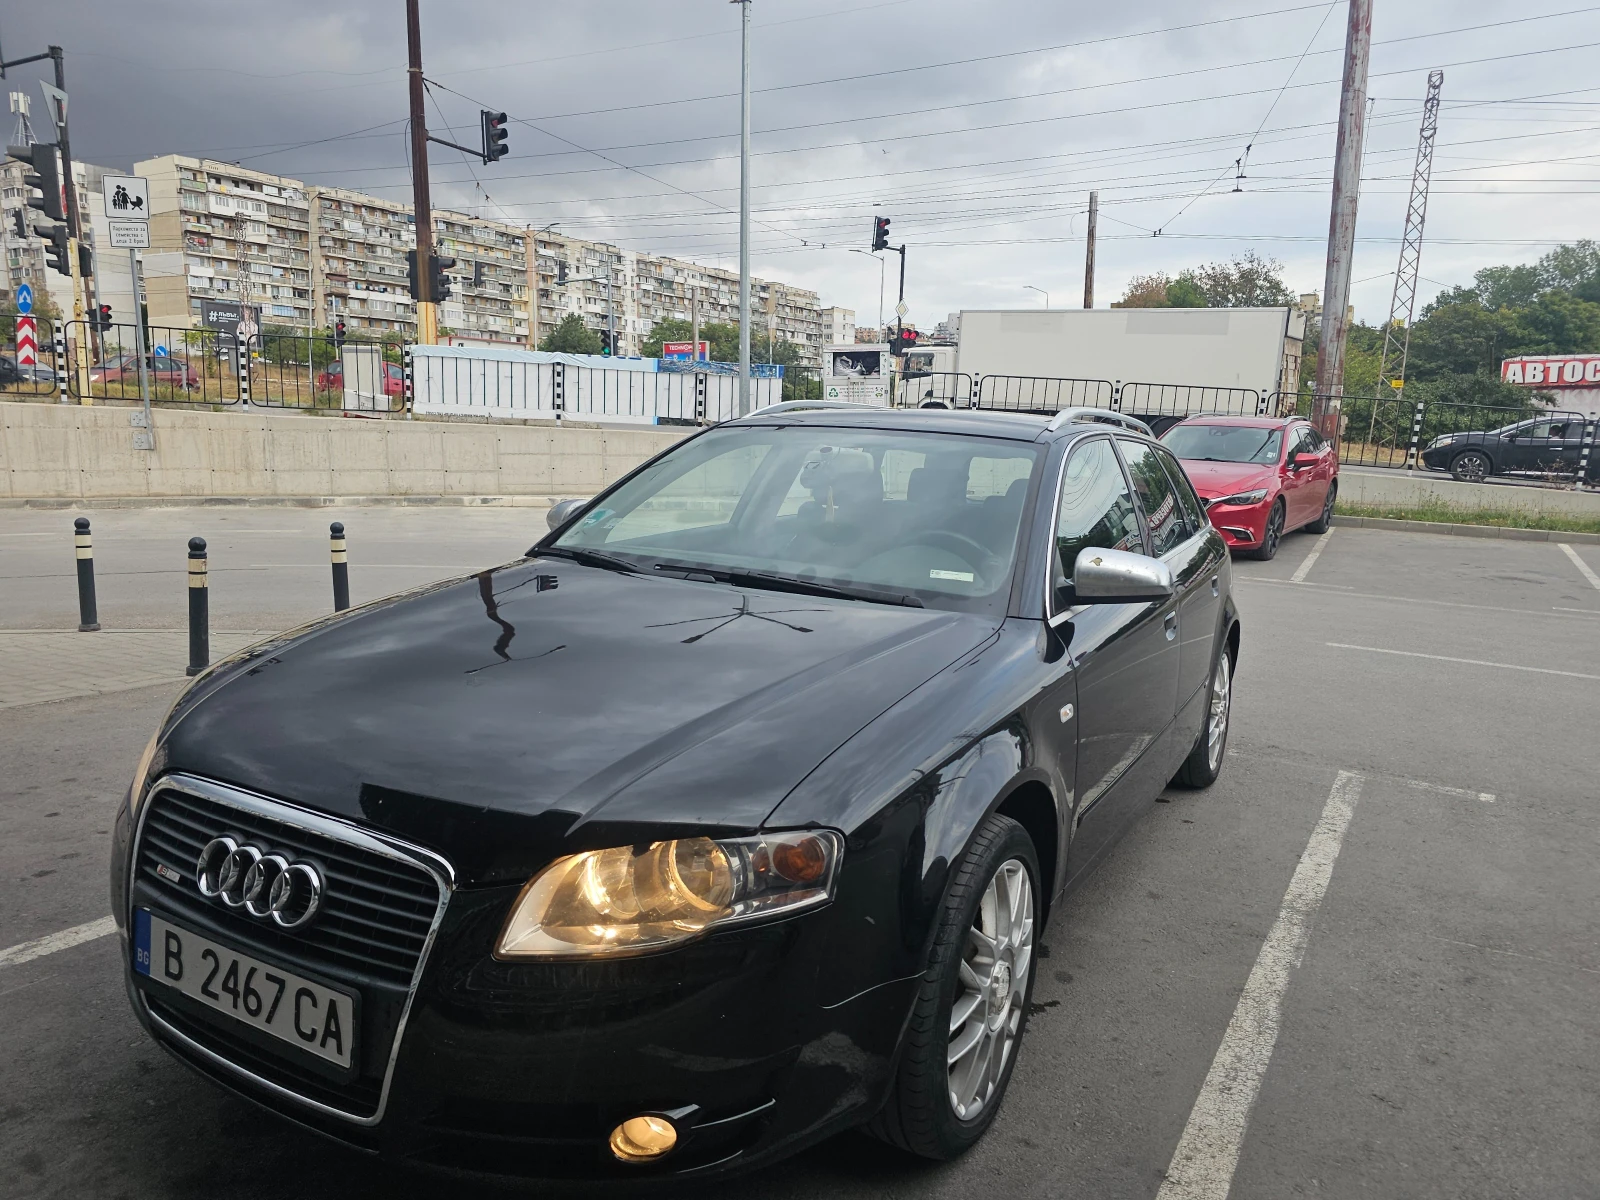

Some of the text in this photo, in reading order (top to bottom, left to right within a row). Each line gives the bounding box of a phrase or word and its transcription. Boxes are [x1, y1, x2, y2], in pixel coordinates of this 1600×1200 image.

[137, 947, 149, 965] BG
[164, 929, 344, 1056] B 2467 CA
